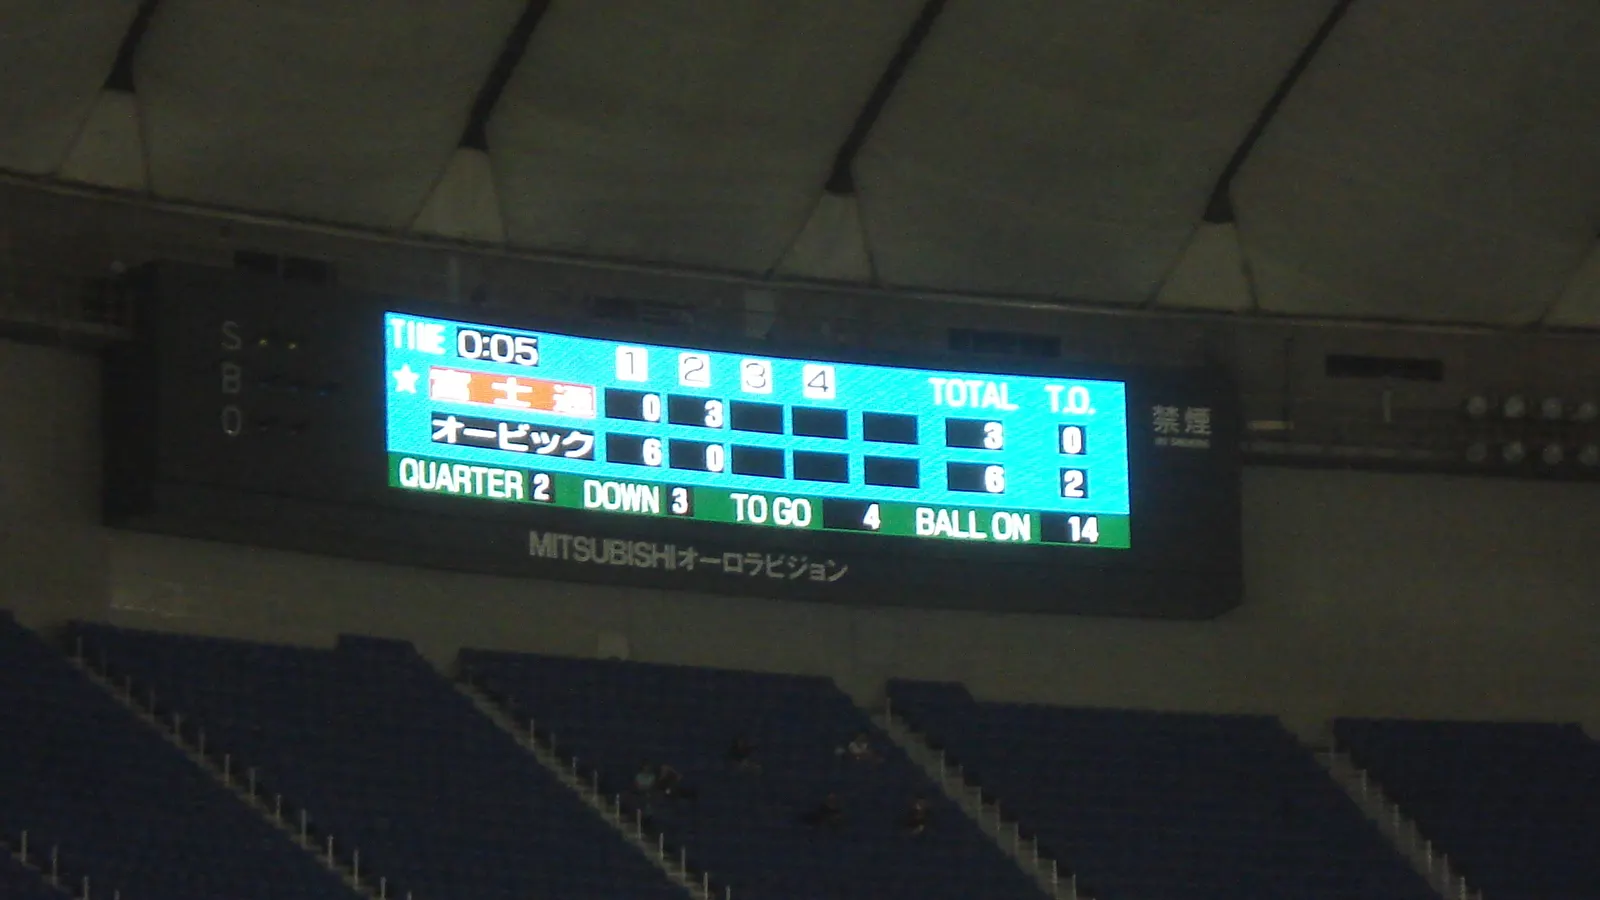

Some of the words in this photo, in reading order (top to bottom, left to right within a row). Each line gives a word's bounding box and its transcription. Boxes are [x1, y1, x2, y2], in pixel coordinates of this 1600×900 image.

[457, 329, 539, 367] 0:05
[683, 355, 703, 382] 2
[744, 361, 767, 389] 3
[806, 369, 830, 393] 4
[928, 377, 1019, 411] TOTAL
[431, 415, 595, 458] オービック
[642, 394, 661, 422] 0
[704, 399, 724, 428] 3
[983, 422, 1004, 450] 3
[1062, 426, 1082, 455] 0
[1152, 404, 1212, 436] 禁煙
[399, 457, 524, 500] QUARTER
[533, 473, 551, 501] 2
[642, 438, 662, 467] 6
[706, 443, 725, 473] 0
[984, 465, 1005, 493] 6
[1063, 468, 1084, 498] 2
[583, 480, 660, 514] DOWN
[671, 487, 690, 514] 3
[730, 492, 768, 524] TO
[772, 496, 812, 527] GO
[863, 503, 881, 531] 4
[915, 507, 987, 540] BALL
[991, 512, 1031, 542] ON
[1067, 515, 1099, 543] 14
[528, 530, 678, 572] MITSUBISHI
[678, 545, 849, 582] オーロラビジョン
